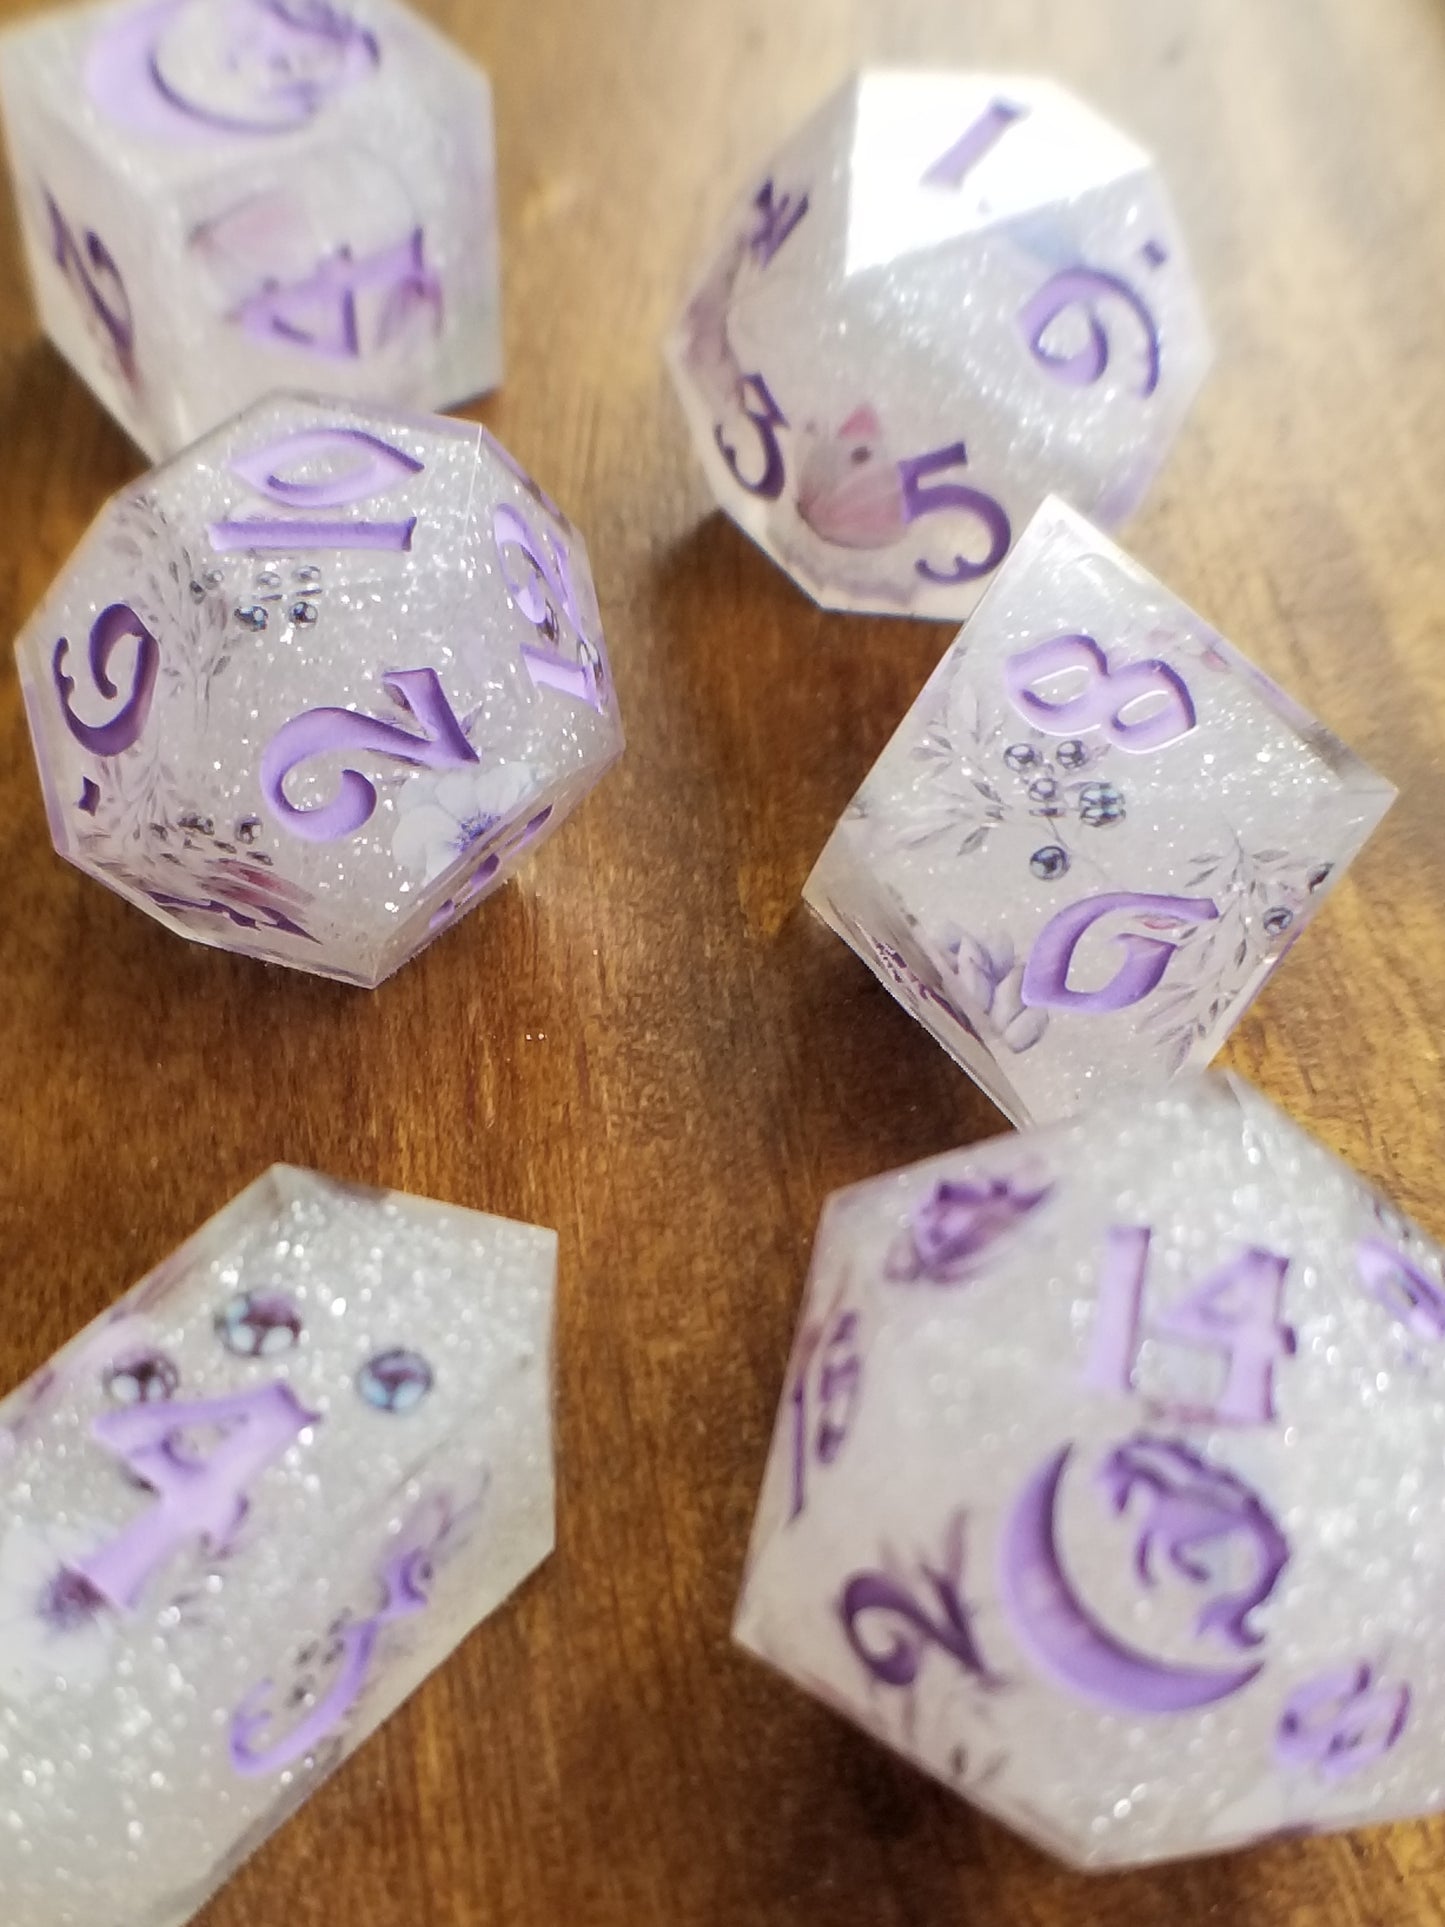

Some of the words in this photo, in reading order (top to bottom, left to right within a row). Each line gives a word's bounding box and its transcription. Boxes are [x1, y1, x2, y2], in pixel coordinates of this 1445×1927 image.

[920, 94, 1030, 192] 1
[207, 426, 424, 554] 10
[714, 372, 790, 502] 3
[898, 441, 1010, 586] 5
[260, 667, 480, 844] 2
[1003, 633, 1197, 754] 8
[1082, 1225, 1298, 1428] 14
[92, 1376, 318, 1612] 4
[838, 1566, 1005, 1692] 2
